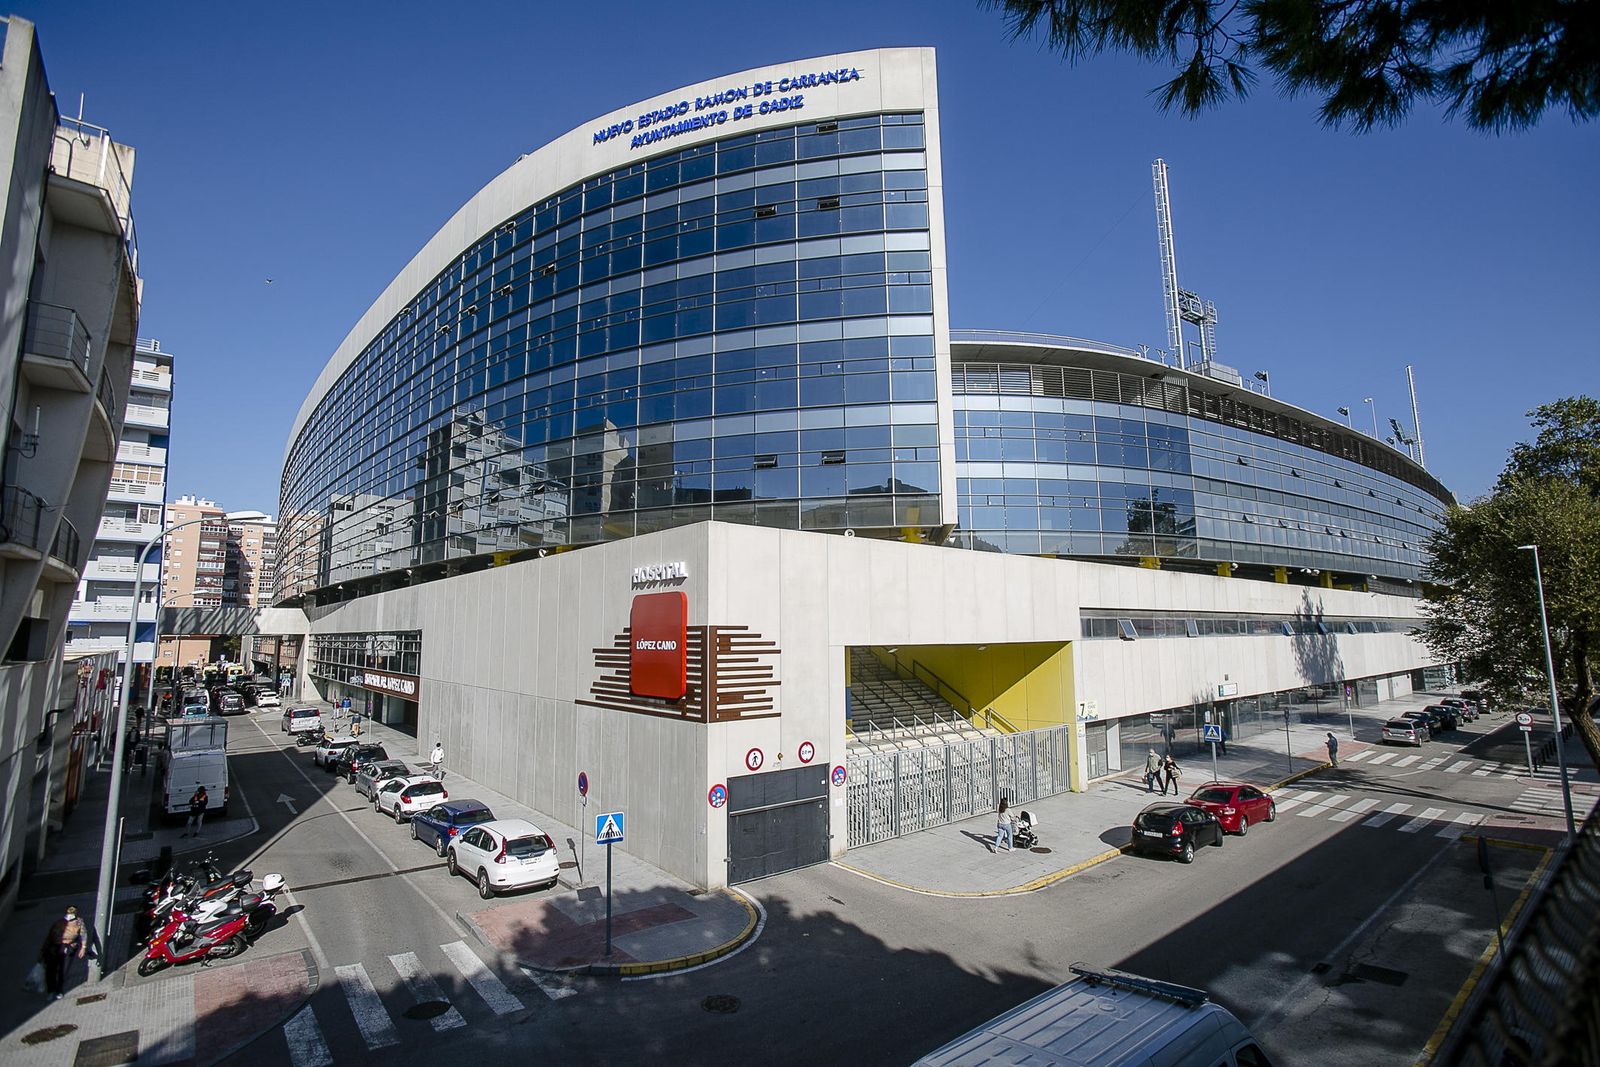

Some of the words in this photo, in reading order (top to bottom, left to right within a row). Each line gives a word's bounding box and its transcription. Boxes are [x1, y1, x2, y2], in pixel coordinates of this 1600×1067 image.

[593, 119, 634, 145] NUEVO
[638, 100, 689, 129] ESTADIO
[753, 81, 772, 97] DE
[779, 67, 859, 92] CARRANZA
[631, 110, 728, 149] AYUNTAMIENTO
[734, 104, 752, 120] DE
[759, 94, 804, 115] CADIZ
[633, 562, 688, 582] HOSPITAL
[636, 638, 656, 650] LÓPEZ
[657, 640, 677, 650] CANO
